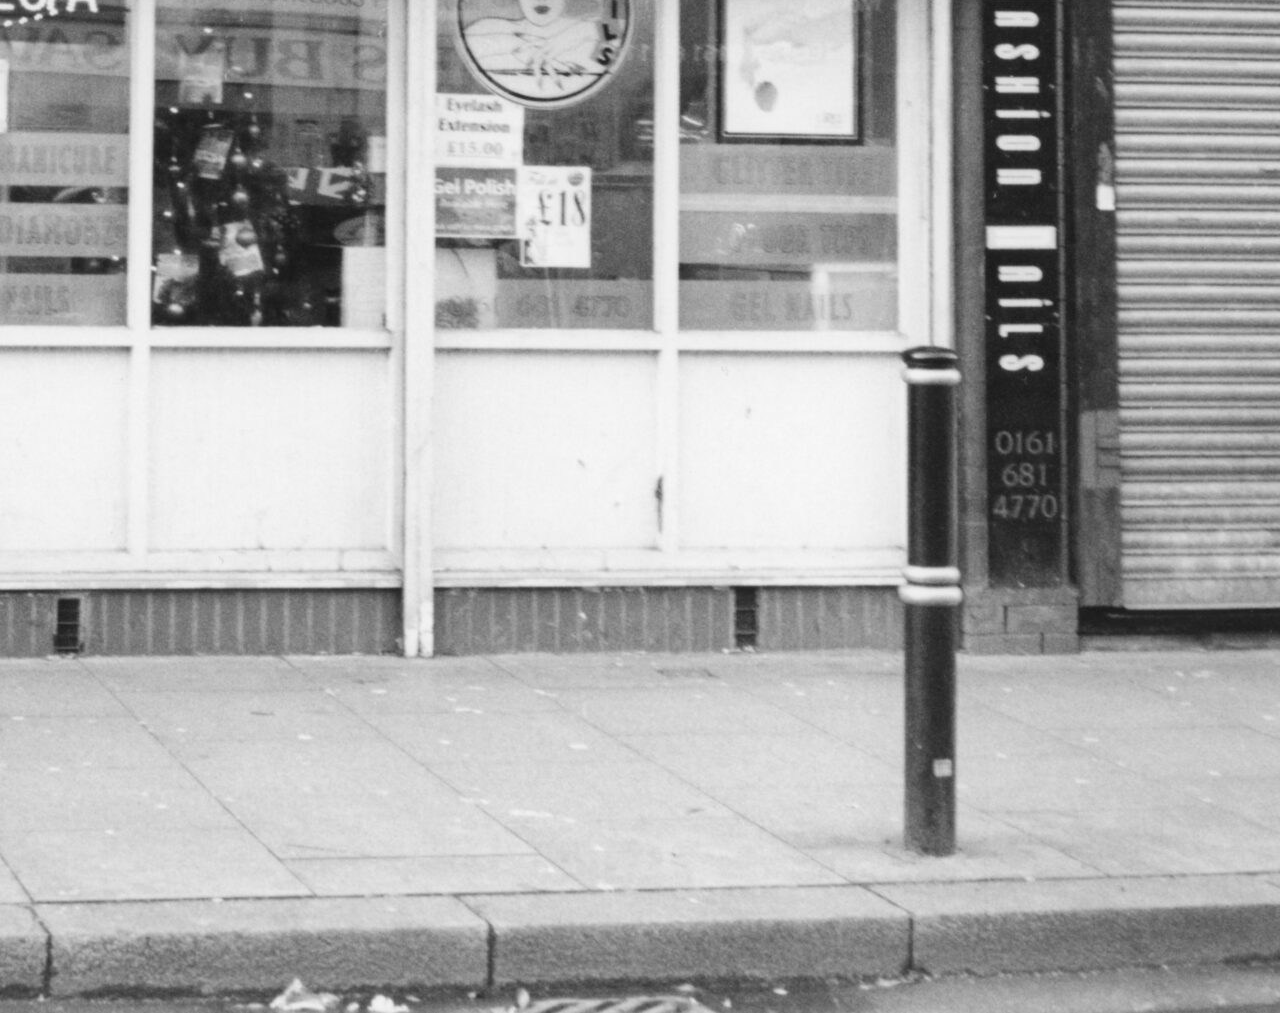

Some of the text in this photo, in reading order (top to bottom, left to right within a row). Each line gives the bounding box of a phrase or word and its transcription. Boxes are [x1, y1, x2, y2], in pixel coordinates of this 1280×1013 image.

[447, 99, 503, 113] Eyelash
[438, 118, 511, 133] Extension
[537, 189, 587, 227] £18
[995, 430, 1055, 456] 0161
[1001, 462, 1048, 488] 681
[992, 495, 1058, 519] 4770
